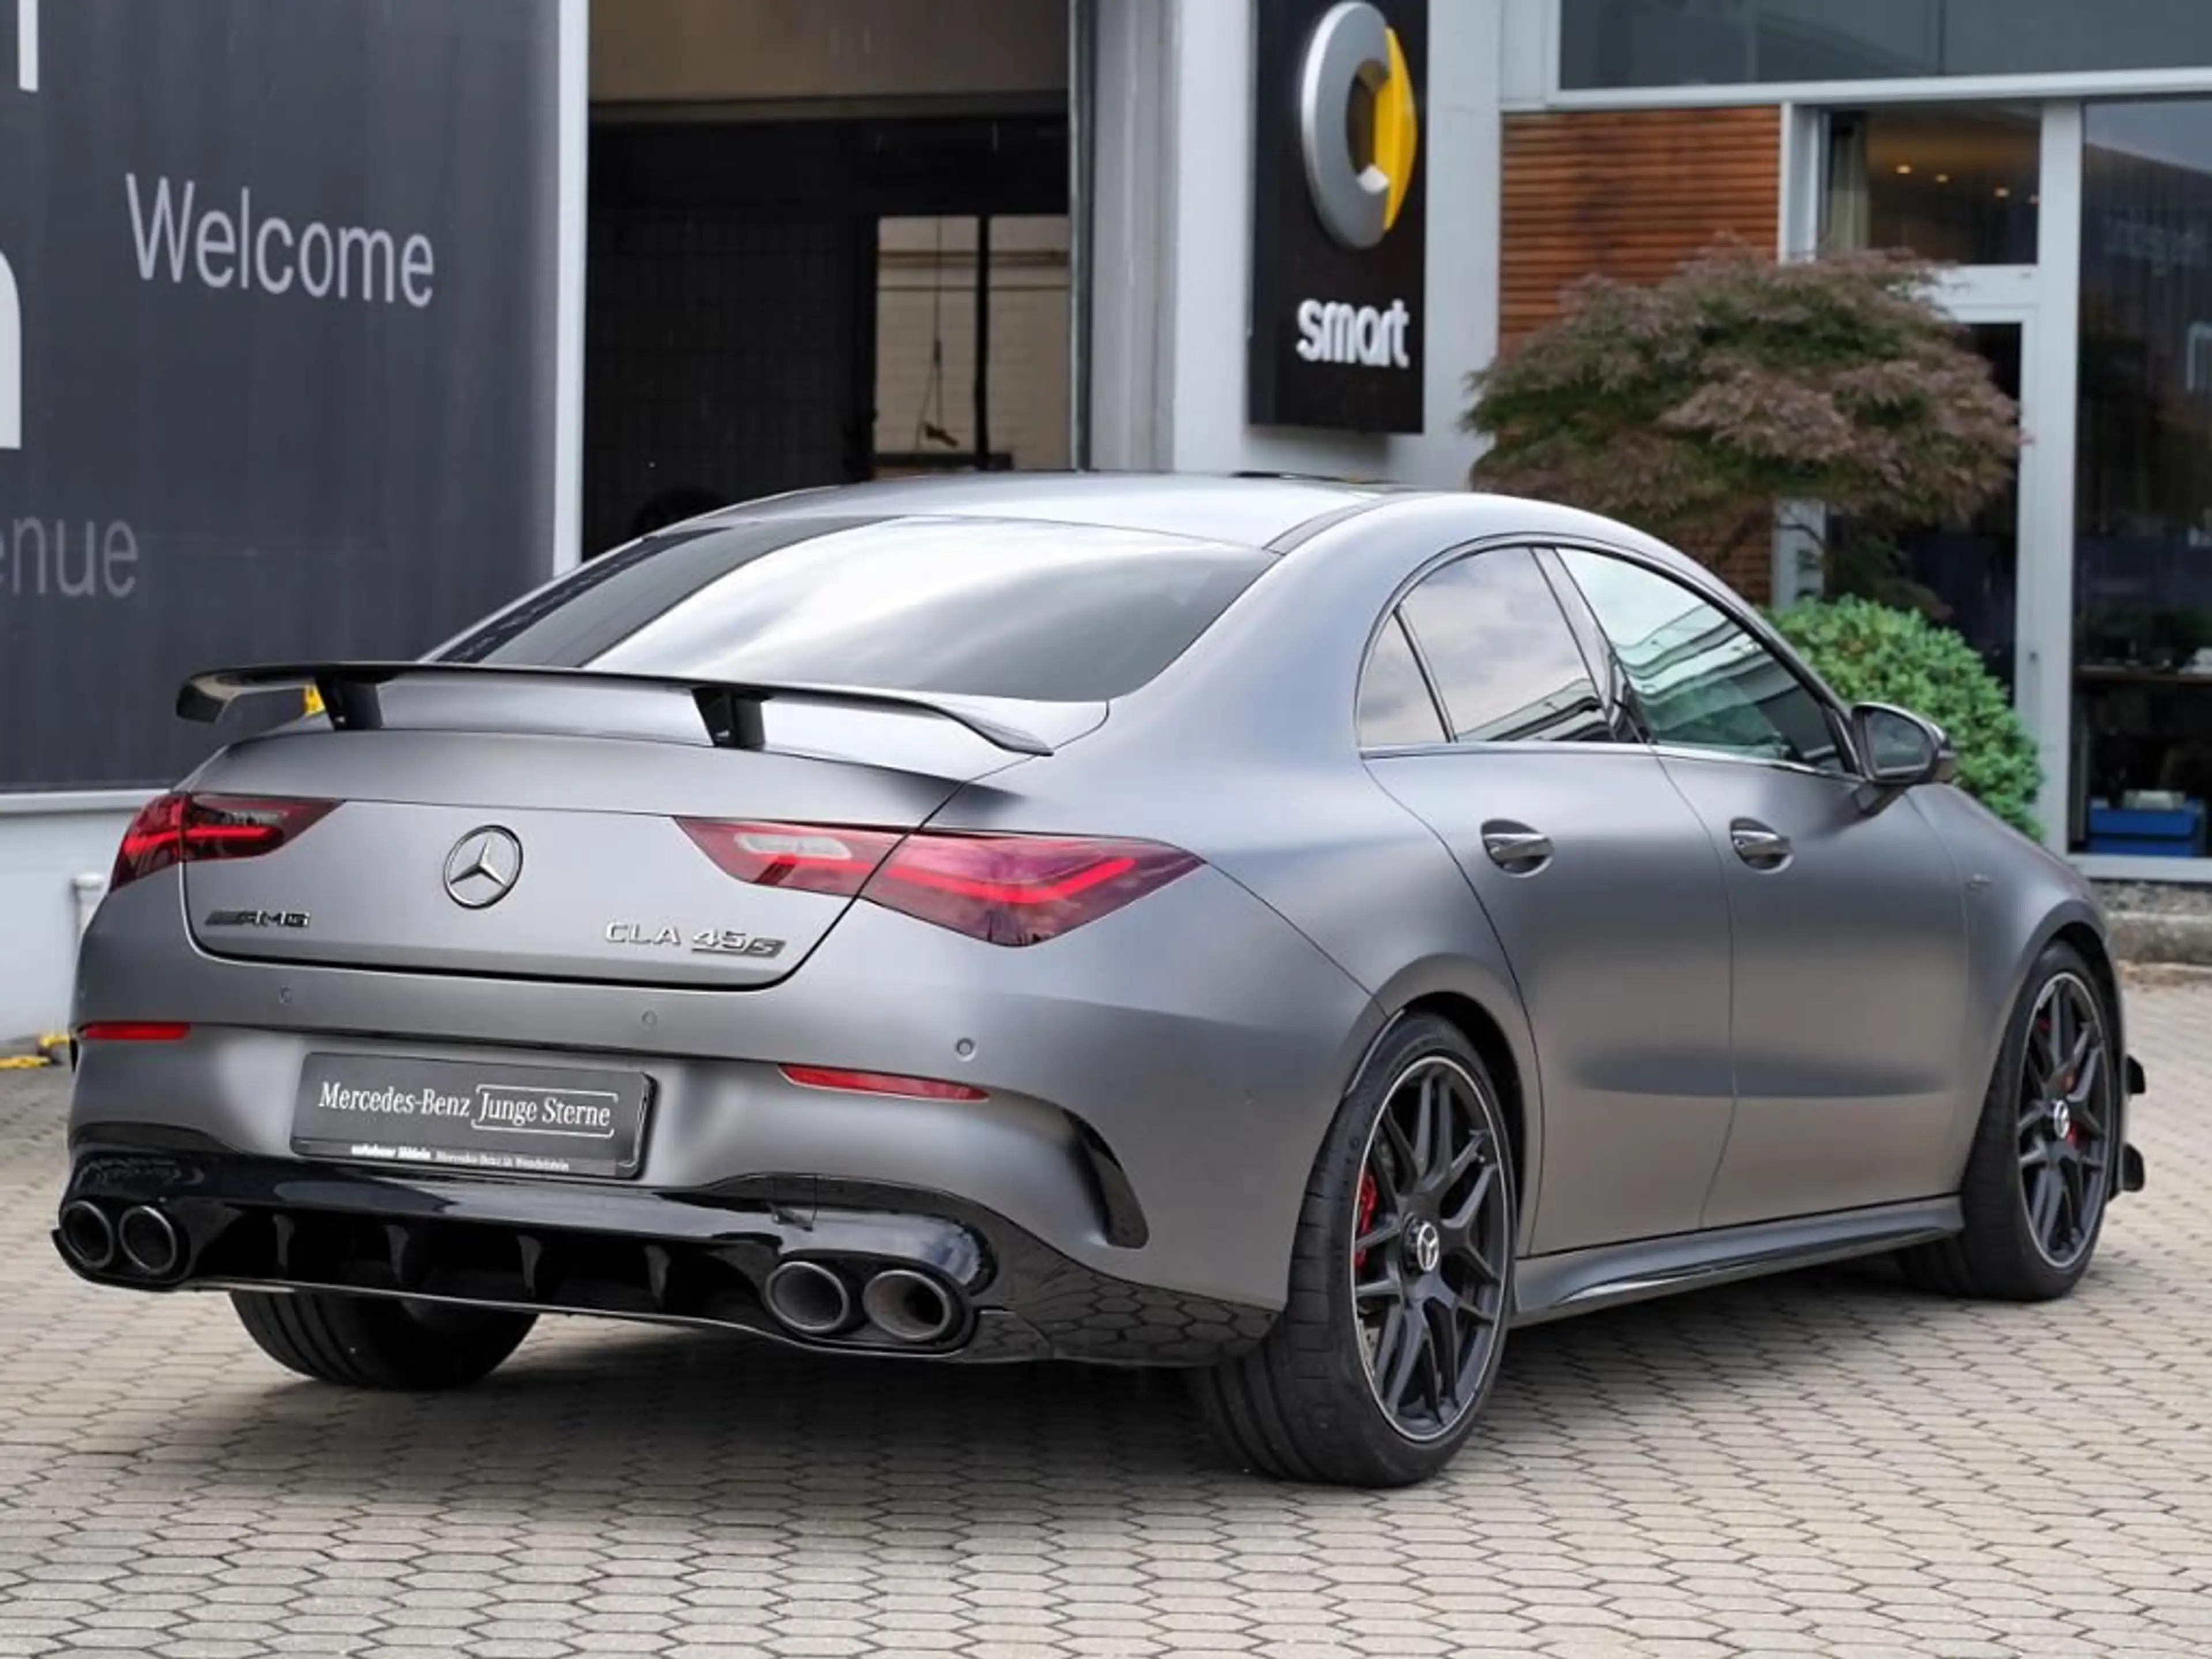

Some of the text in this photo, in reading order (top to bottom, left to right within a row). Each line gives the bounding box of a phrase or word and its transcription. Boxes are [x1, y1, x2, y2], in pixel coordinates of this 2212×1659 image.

[125, 172, 434, 308] Welcome
[1296, 298, 1410, 369] smart
[0, 516, 138, 598] nue
[230, 910, 312, 928] AMG
[605, 921, 681, 946] CLA
[318, 1081, 611, 1127] Mercedes-Benz Junge Sterne
